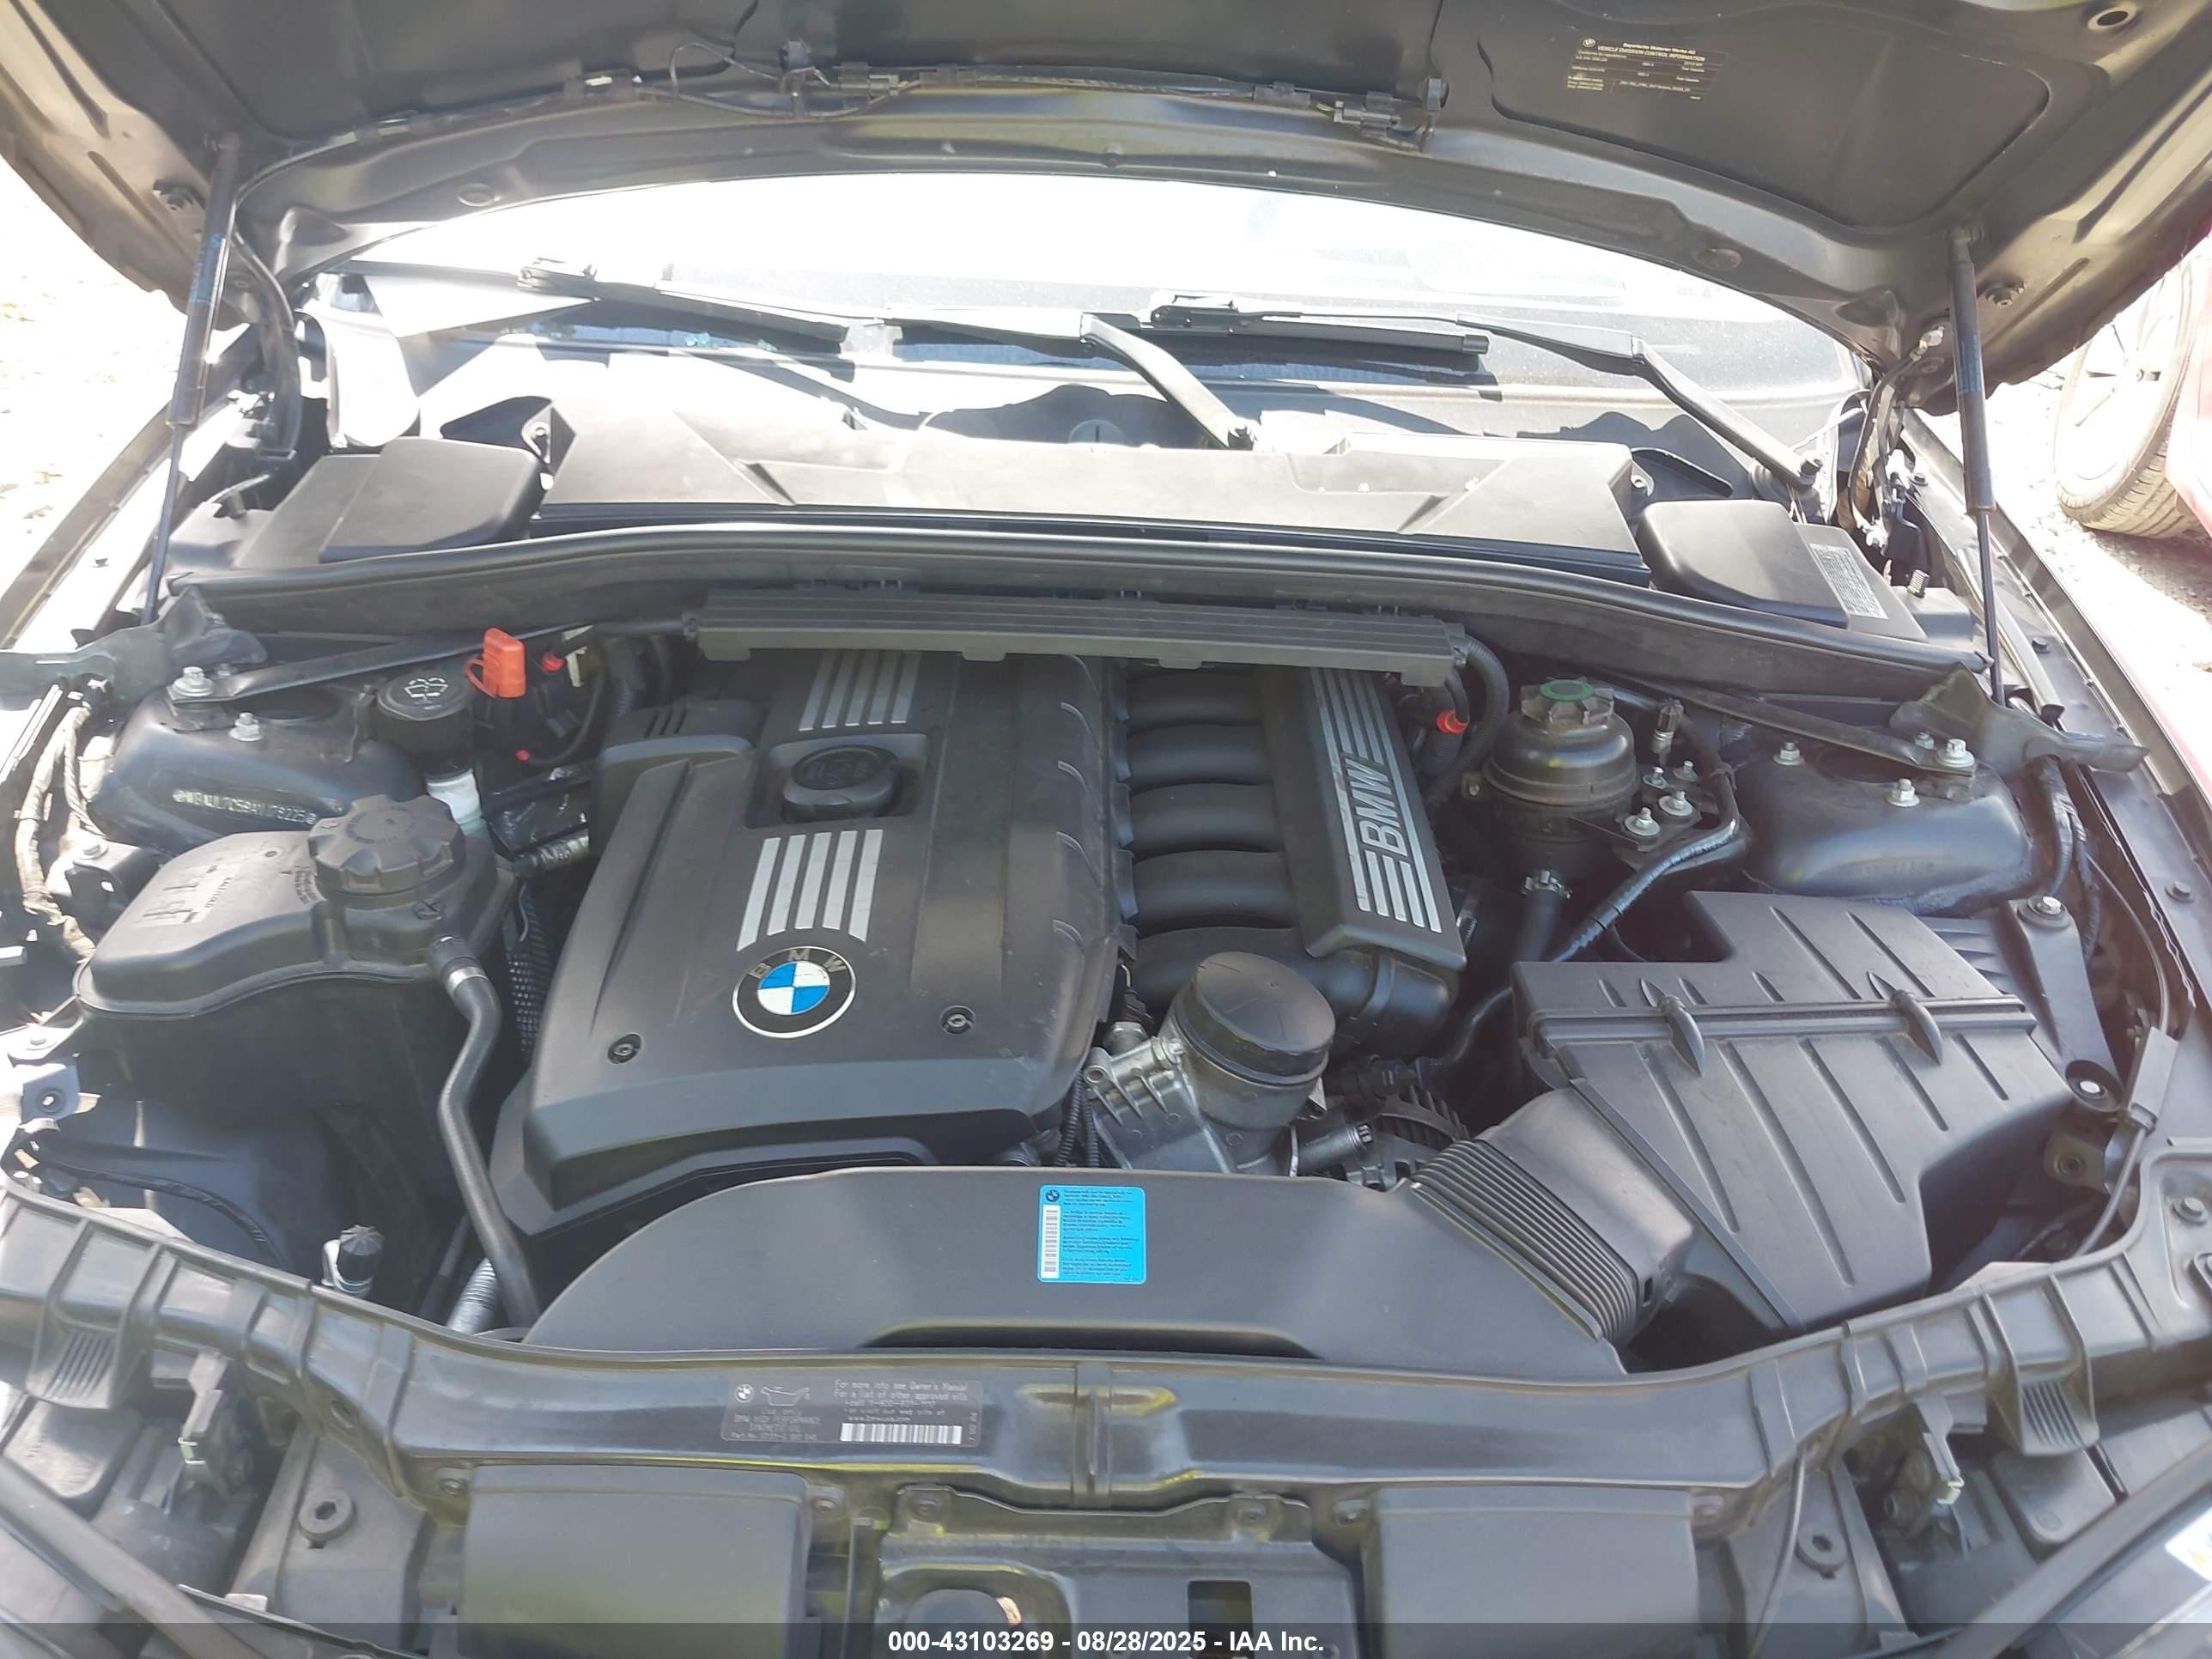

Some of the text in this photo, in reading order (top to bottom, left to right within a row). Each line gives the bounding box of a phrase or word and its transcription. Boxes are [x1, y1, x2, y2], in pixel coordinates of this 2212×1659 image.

[1345, 757, 1408, 857] BMW
[835, 1378, 848, 1389] For
[834, 1388, 848, 1398] For
